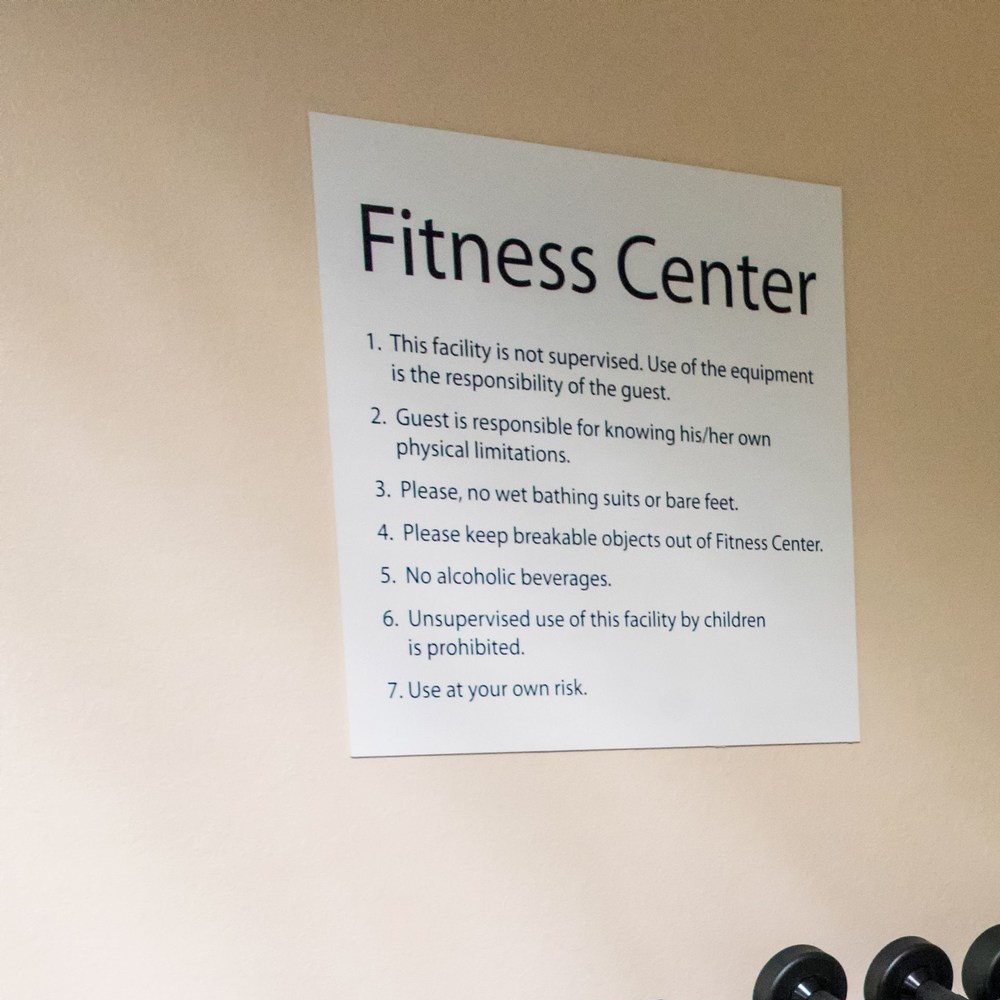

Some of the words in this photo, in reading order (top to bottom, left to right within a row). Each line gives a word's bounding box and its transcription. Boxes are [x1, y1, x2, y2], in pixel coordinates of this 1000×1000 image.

[360, 203, 597, 294] Fitness
[617, 235, 816, 315] Center
[366, 332, 382, 352] 1.
[388, 332, 429, 355] This
[431, 335, 492, 364] facility
[495, 342, 510, 361] is
[513, 347, 545, 364] not
[547, 350, 644, 372] supervised.
[647, 354, 678, 375] Use
[680, 357, 698, 376] of
[699, 358, 728, 379] the
[729, 363, 815, 386] equipment
[391, 363, 406, 383] is
[408, 364, 441, 385] the
[445, 371, 564, 398] responsibility
[567, 376, 586, 395] of
[588, 377, 617, 398] the
[620, 384, 671, 403] guest.
[370, 406, 387, 425] 2.
[395, 407, 450, 429] Guest
[453, 410, 469, 430] is
[472, 415, 573, 437] responsible
[576, 417, 601, 438] for
[604, 419, 676, 447] knowing
[679, 424, 735, 445] his/her
[737, 432, 772, 448] own
[396, 436, 470, 462] physical
[474, 440, 571, 464] limitations.
[375, 479, 392, 498] 3.
[400, 479, 463, 504] Please,
[467, 487, 491, 502] no
[494, 487, 529, 504] wet
[532, 484, 599, 511] bathing
[602, 489, 641, 508] suits
[644, 494, 662, 509] or
[665, 490, 702, 510] bare
[704, 492, 739, 512] feet.
[376, 523, 394, 541] 4.
[403, 522, 461, 543] Please
[465, 524, 509, 549] keep
[512, 525, 598, 547] breakable
[601, 528, 662, 552] objects
[664, 533, 693, 550] out
[695, 531, 713, 550] of
[715, 532, 769, 551] Fitness
[771, 534, 824, 553] Center.
[380, 566, 397, 584] 5.
[405, 565, 433, 585] No
[436, 565, 517, 586] alcoholic
[520, 567, 612, 592] beverages.
[382, 609, 400, 628] 6.
[408, 608, 531, 632] Unsupervised
[535, 614, 565, 628] use
[568, 609, 587, 628] of
[589, 609, 621, 628] this
[623, 609, 677, 633] facility
[680, 610, 701, 633] by
[703, 610, 766, 629] children
[407, 638, 423, 657] is
[426, 636, 525, 661] prohibited.
[386, 681, 404, 700] 7.
[407, 680, 442, 699] Use
[446, 682, 464, 699] at
[467, 683, 509, 703] your
[512, 683, 550, 697] own
[554, 677, 588, 697] risk.
